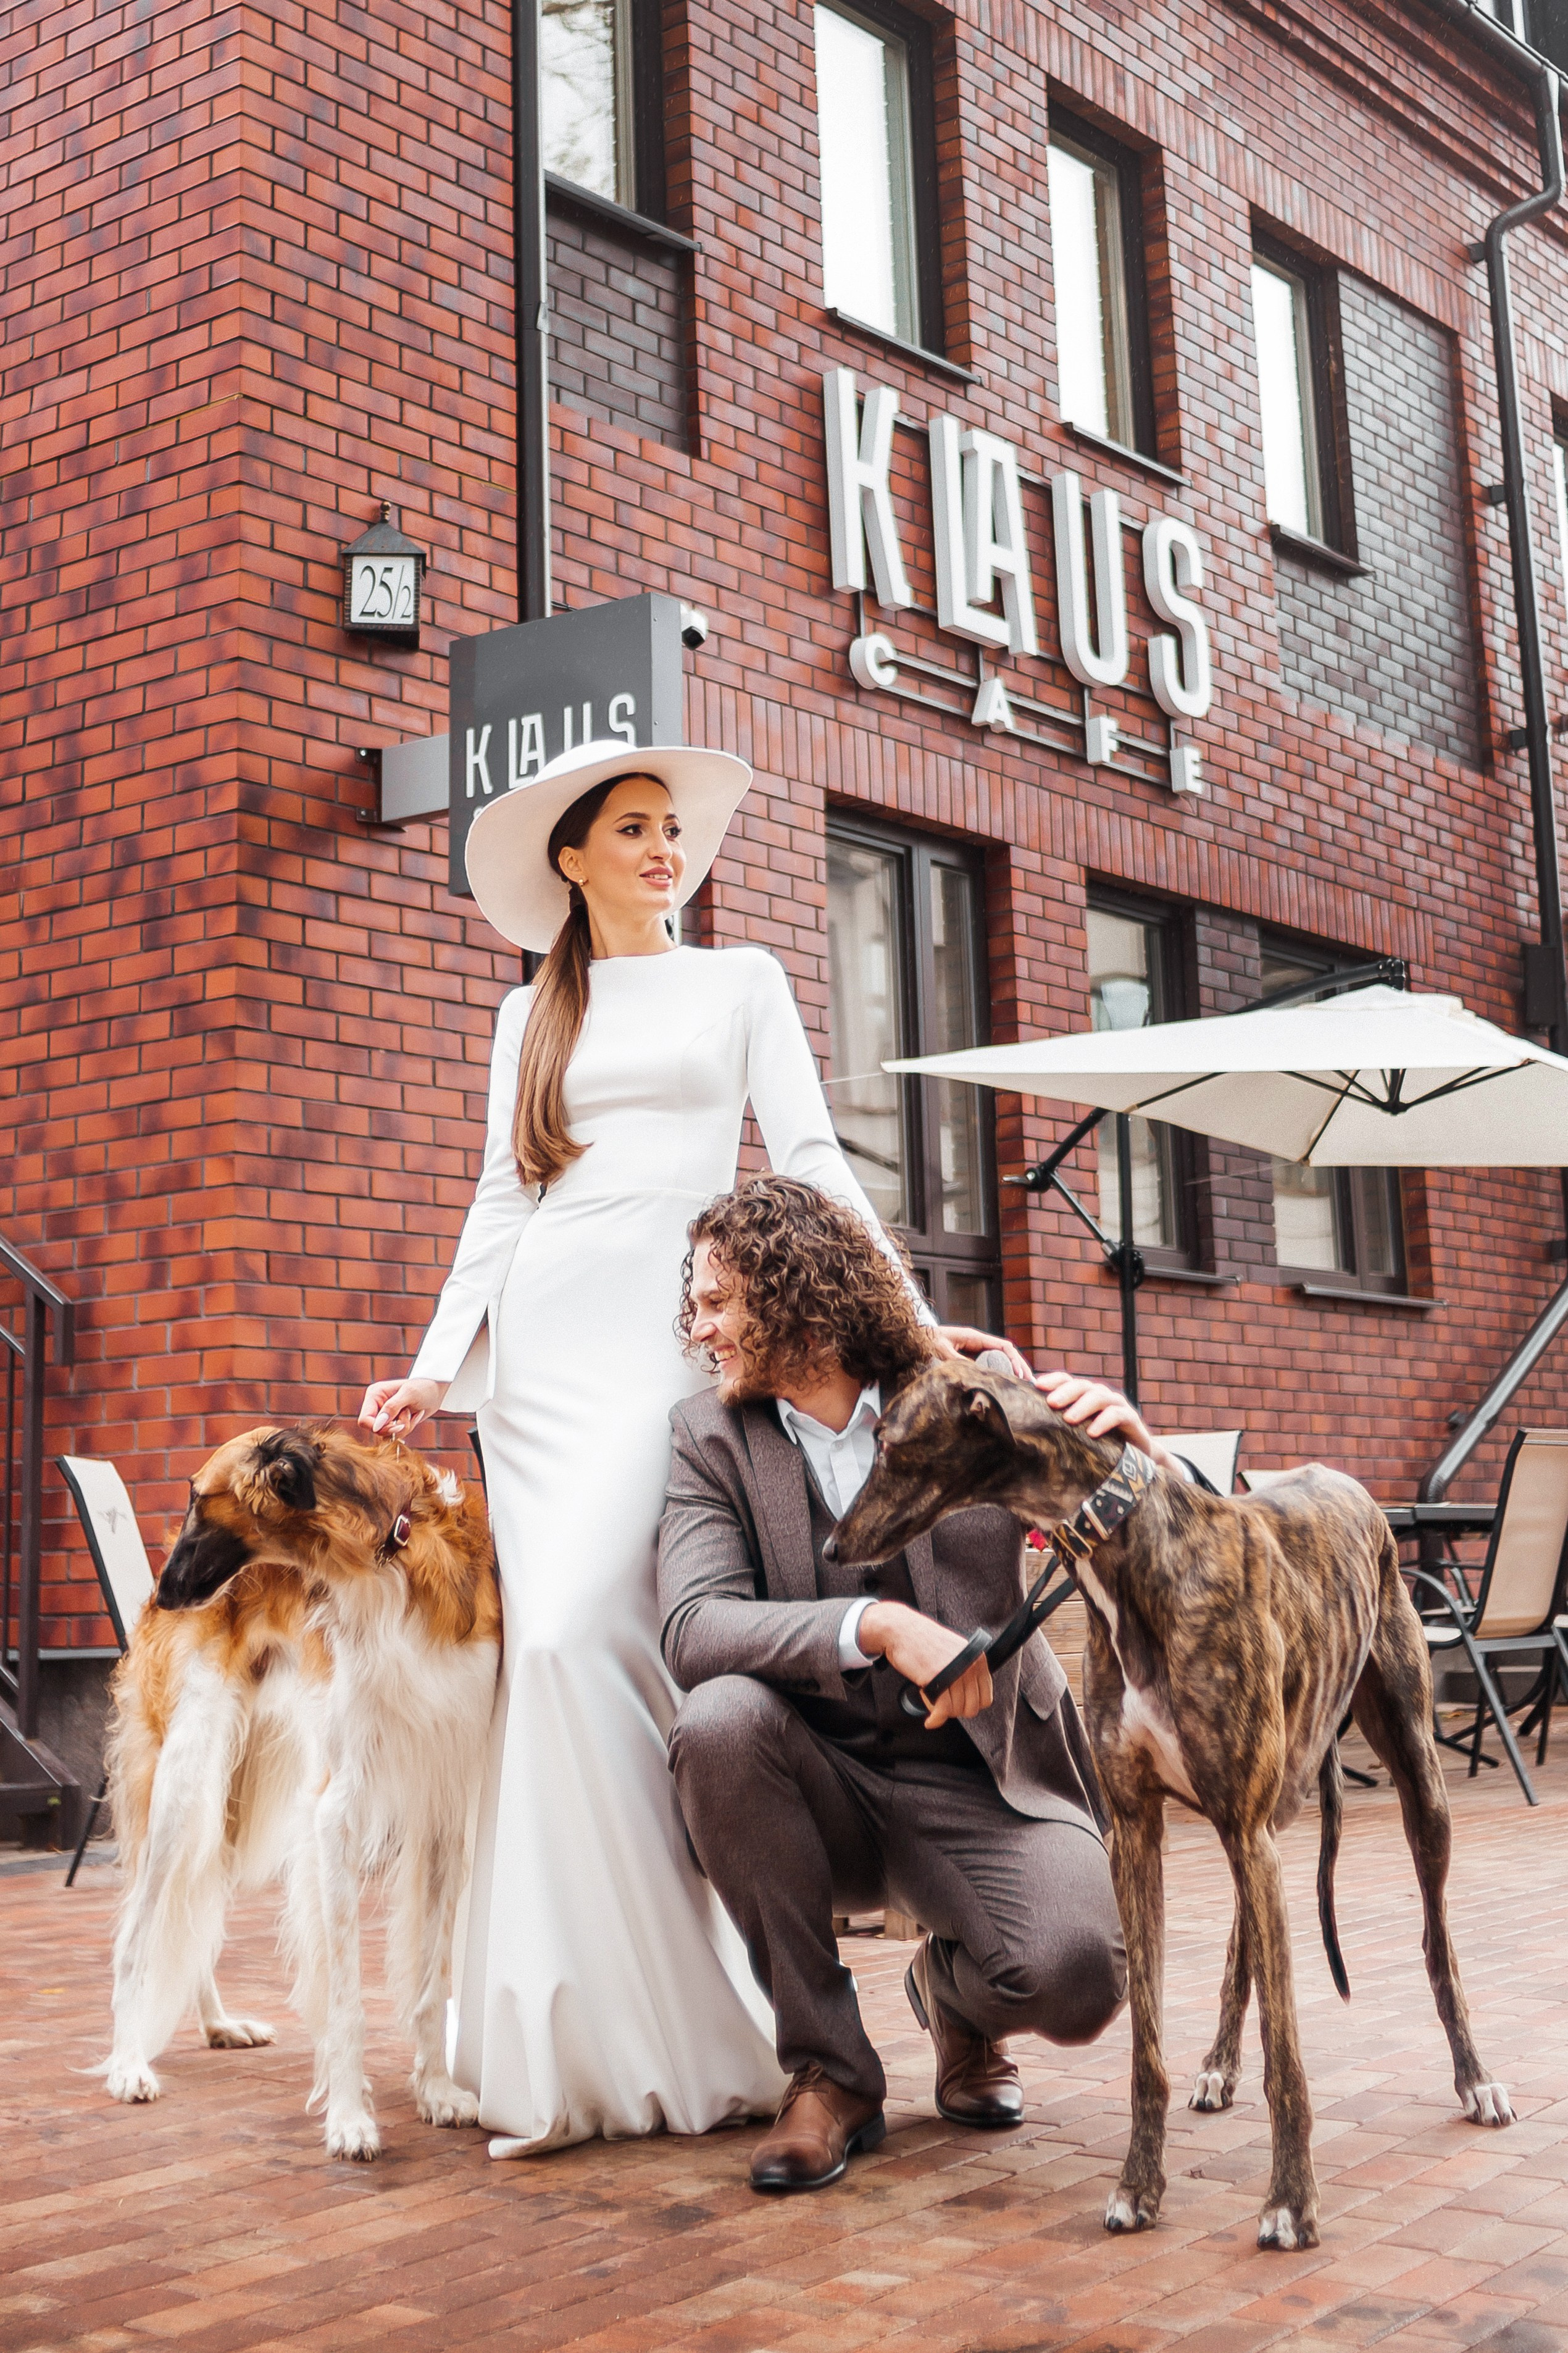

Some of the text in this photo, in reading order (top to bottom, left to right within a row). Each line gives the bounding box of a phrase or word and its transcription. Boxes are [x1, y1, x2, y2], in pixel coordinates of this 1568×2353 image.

[359, 565, 412, 619] 25/2
[823, 366, 1212, 719] KLAUS
[849, 633, 1204, 796] CAFE
